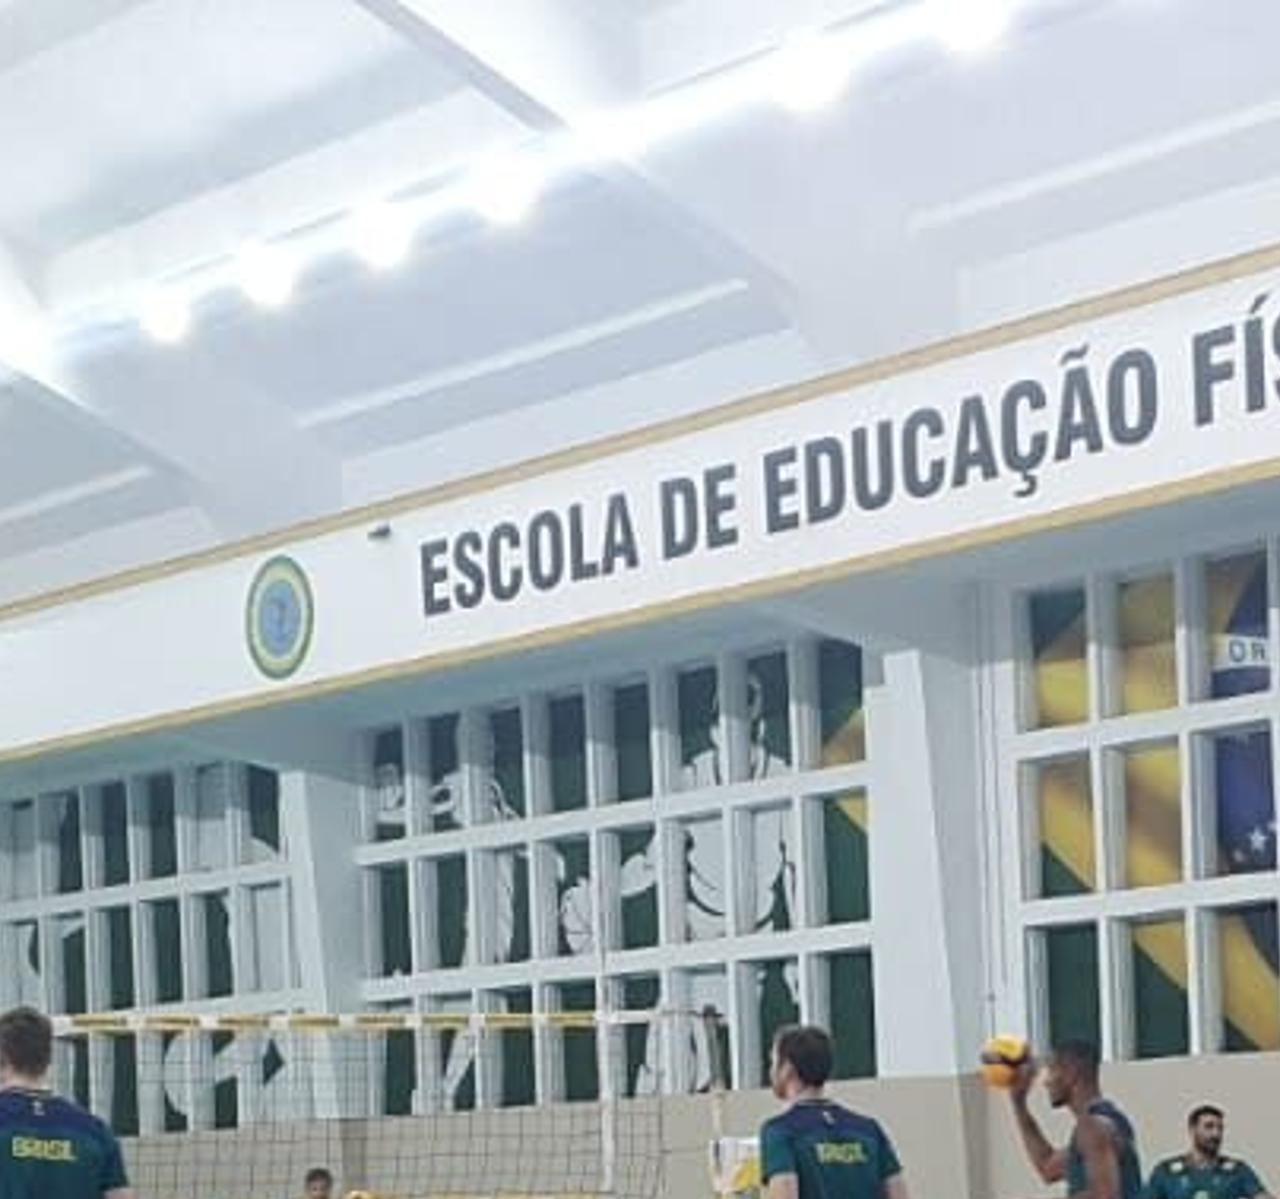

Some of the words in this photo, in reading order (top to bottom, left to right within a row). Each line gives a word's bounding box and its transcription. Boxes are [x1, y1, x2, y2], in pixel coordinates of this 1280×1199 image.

[420, 493, 639, 617] ESCOLA
[660, 463, 739, 561] DE
[763, 345, 1158, 535] EDUCAÇÃO
